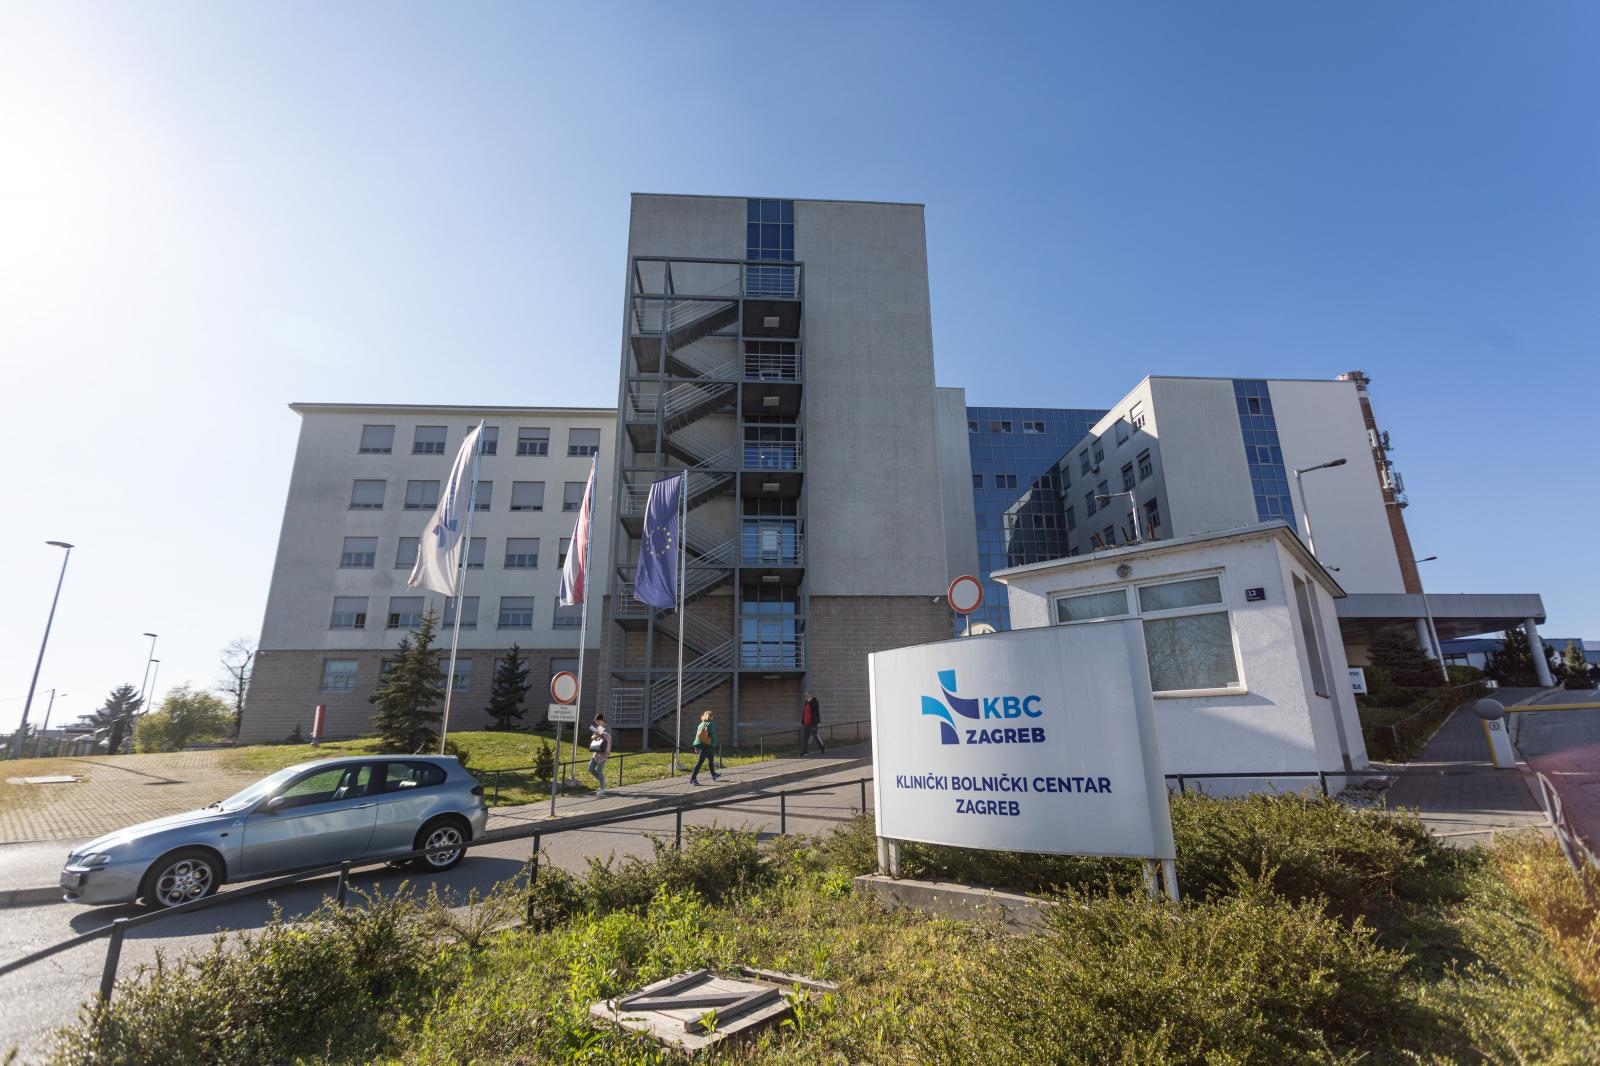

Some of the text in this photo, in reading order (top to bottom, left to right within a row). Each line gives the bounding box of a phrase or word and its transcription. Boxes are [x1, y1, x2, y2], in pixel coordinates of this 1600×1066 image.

[983, 695, 1043, 719] KBC
[965, 727, 1046, 745] ZAGREB
[896, 772, 1113, 794] KLINIČKI BOLNIČKI CENTAR
[955, 799, 1021, 816] ZAGREB
